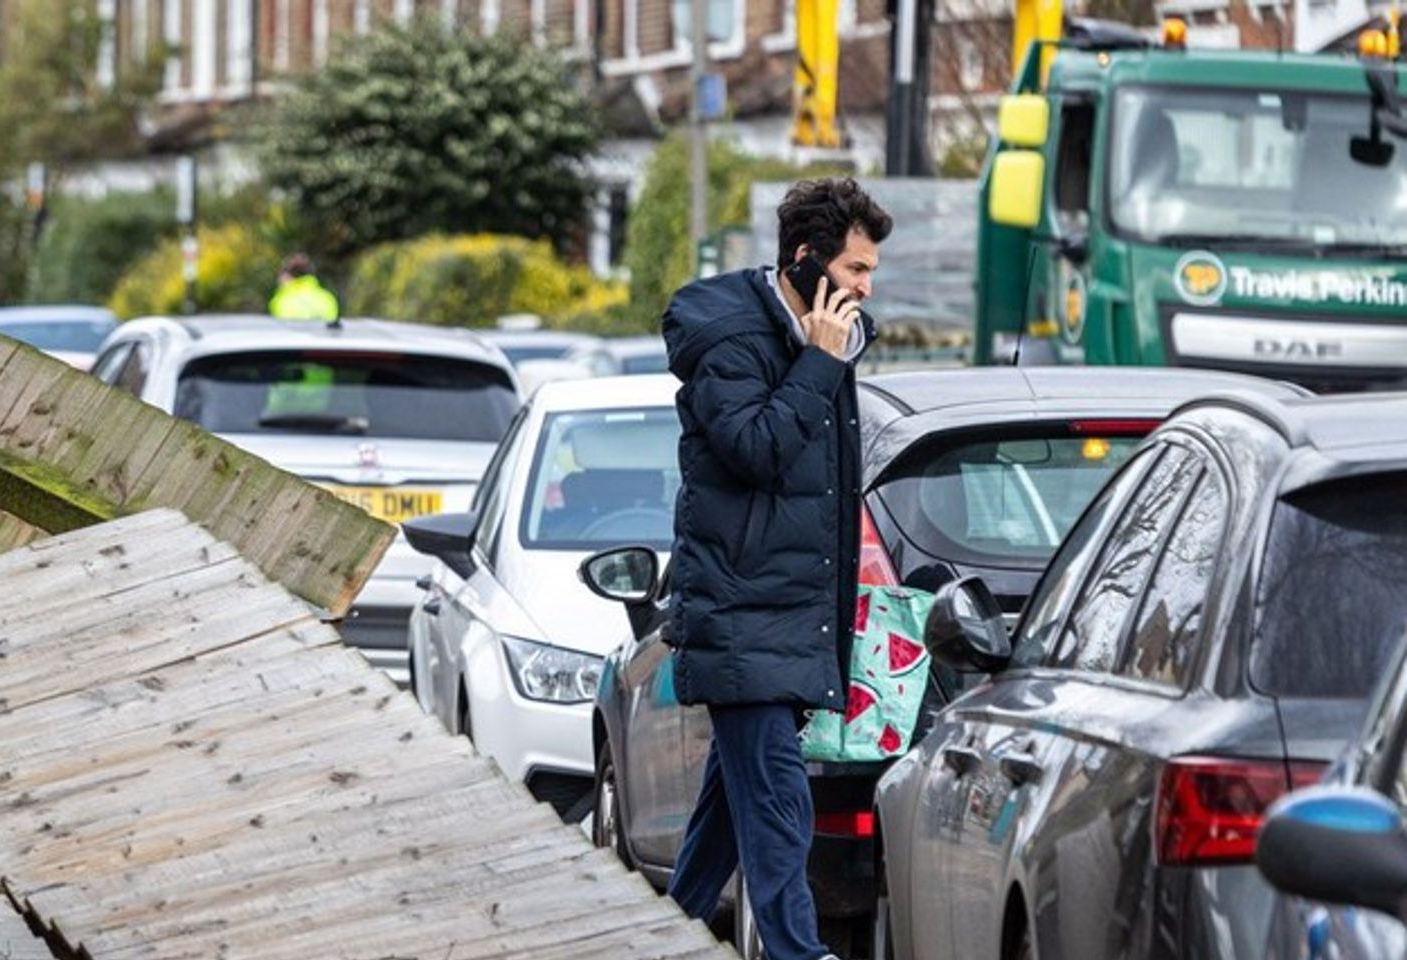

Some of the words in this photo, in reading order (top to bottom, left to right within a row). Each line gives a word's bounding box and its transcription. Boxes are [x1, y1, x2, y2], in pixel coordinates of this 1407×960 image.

[1230, 266, 1314, 299] Travis
[1319, 270, 1407, 307] Perkin
[1253, 338, 1343, 358] DAF
